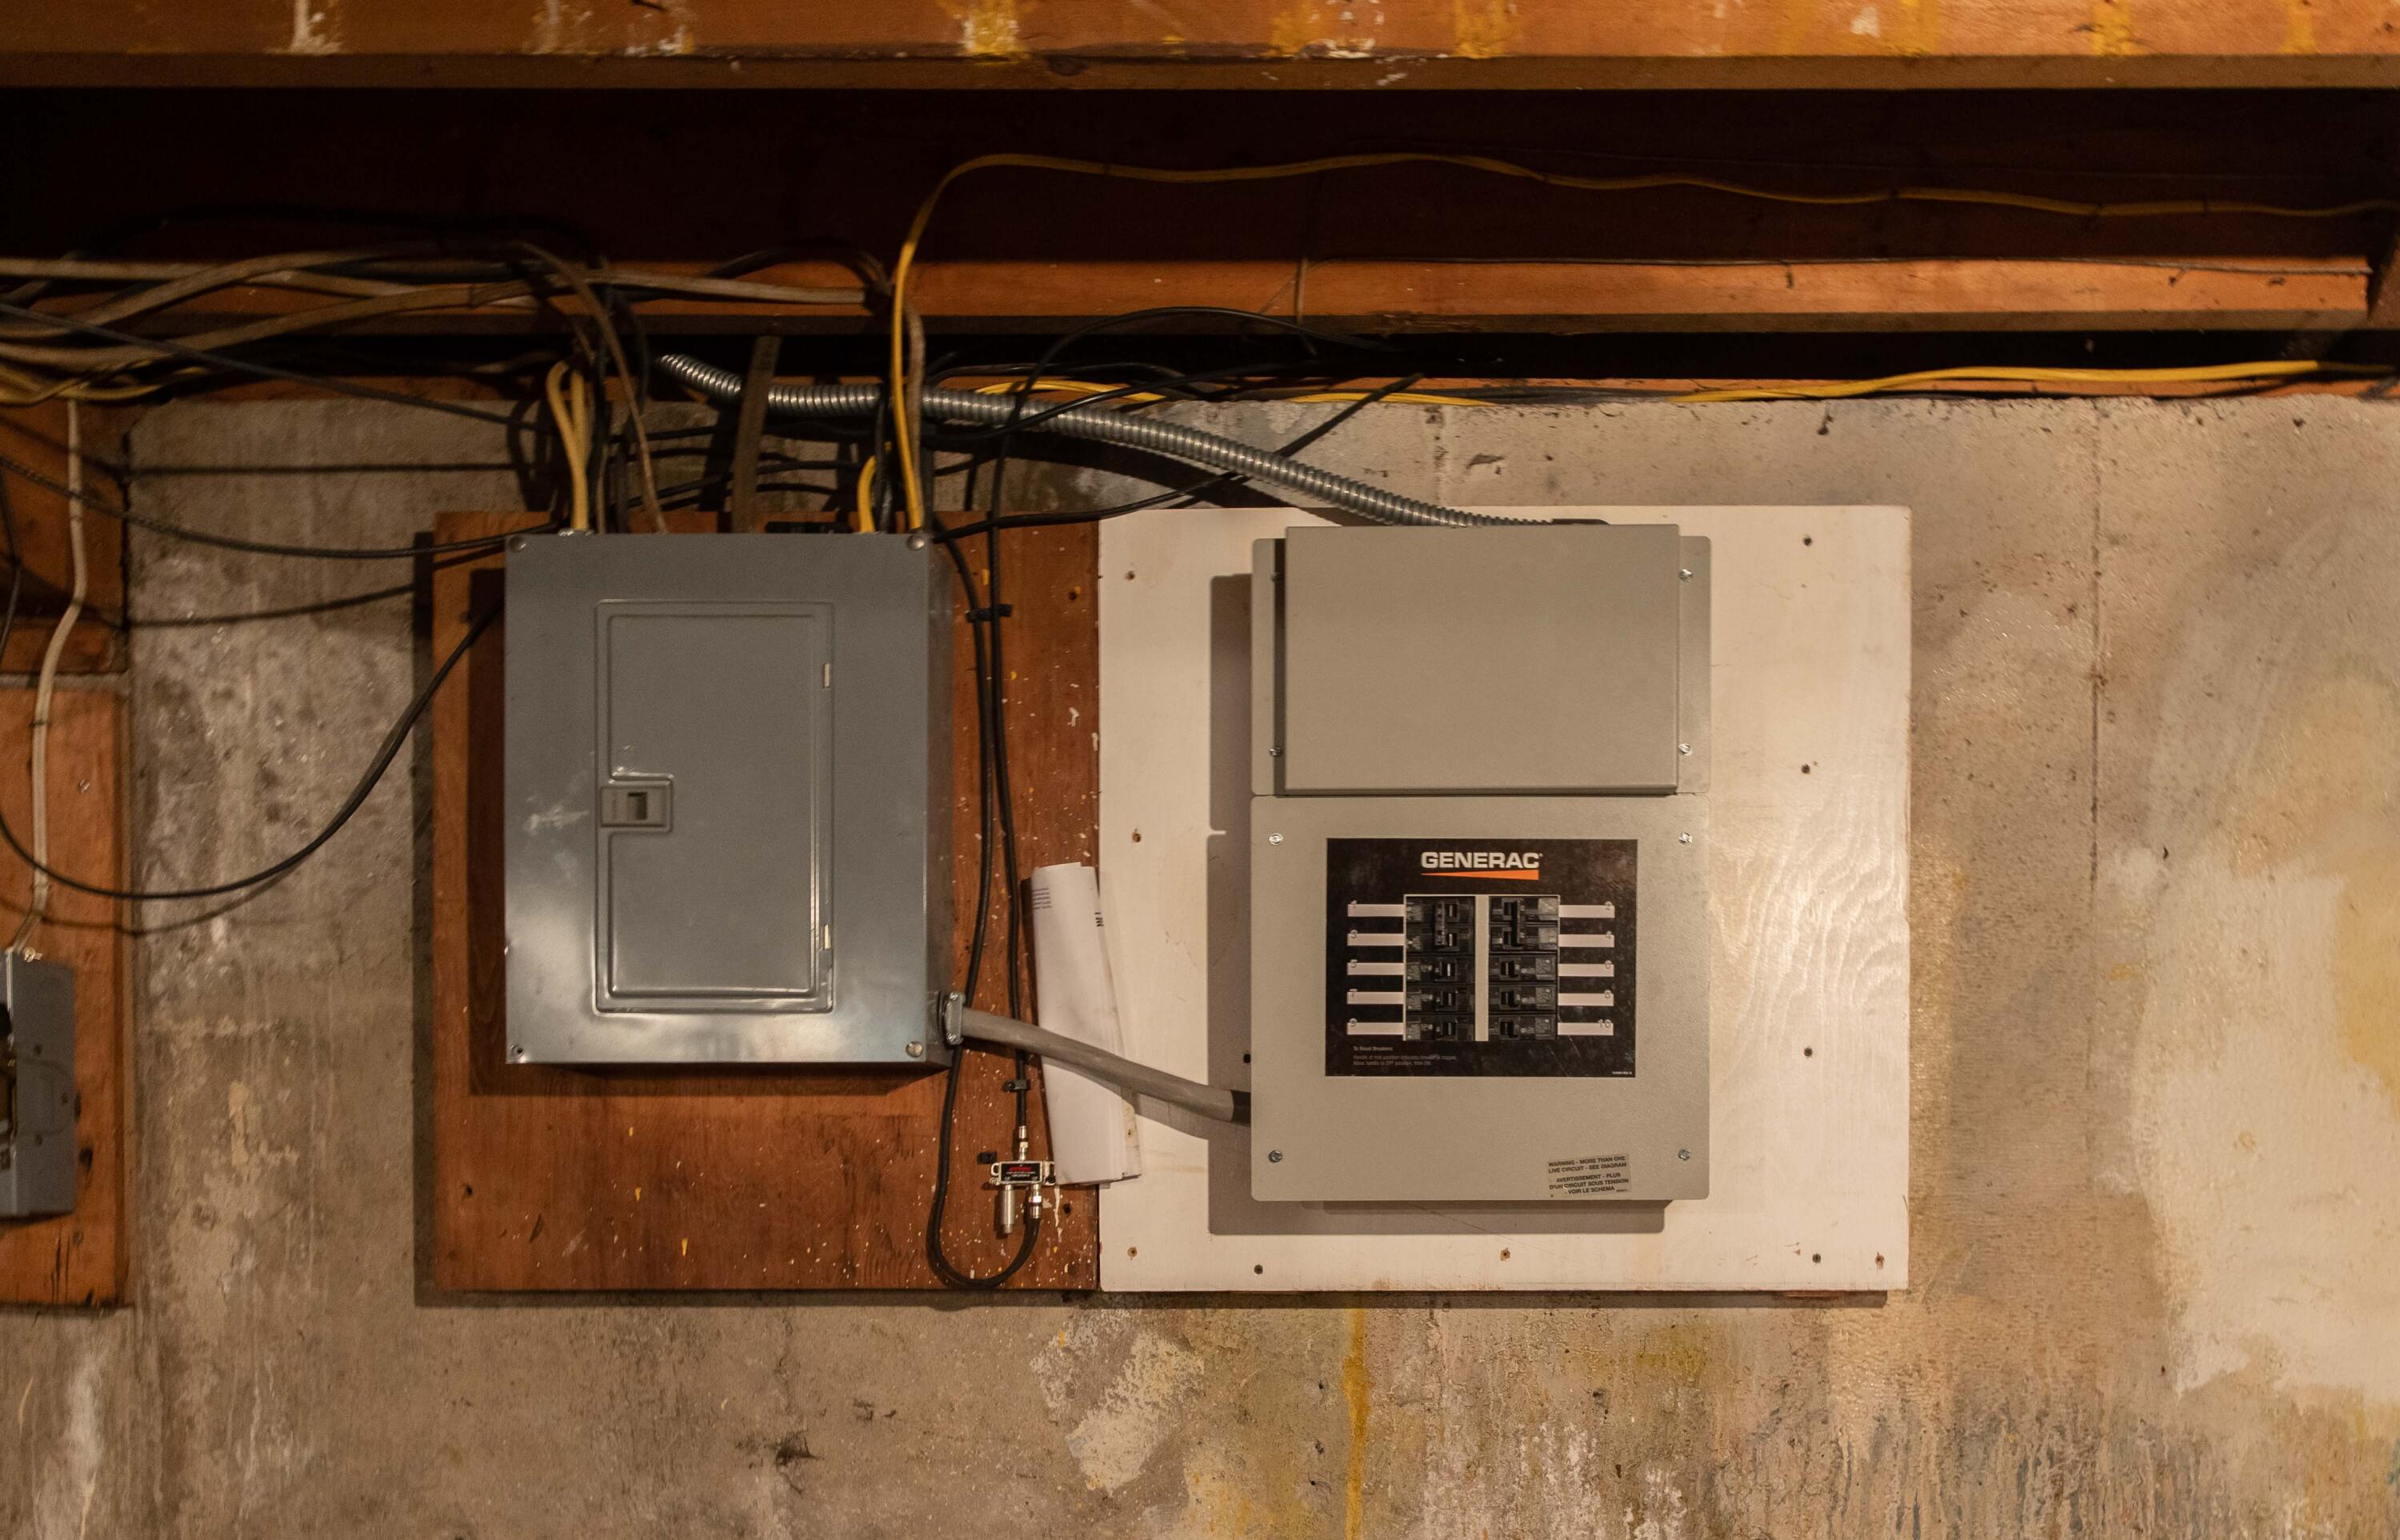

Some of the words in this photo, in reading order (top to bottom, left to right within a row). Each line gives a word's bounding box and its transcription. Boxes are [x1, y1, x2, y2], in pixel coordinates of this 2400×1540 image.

[1421, 851, 1539, 869] GENERAC
[1350, 930, 1358, 938] 3
[1605, 930, 1613, 940] 4
[1350, 959, 1358, 968] 5
[1349, 988, 1358, 998] 7
[1350, 1018, 1358, 1027] 9
[1598, 1018, 1611, 1028] 10
[1556, 1174, 1602, 1182] AVERTISSEMENT
